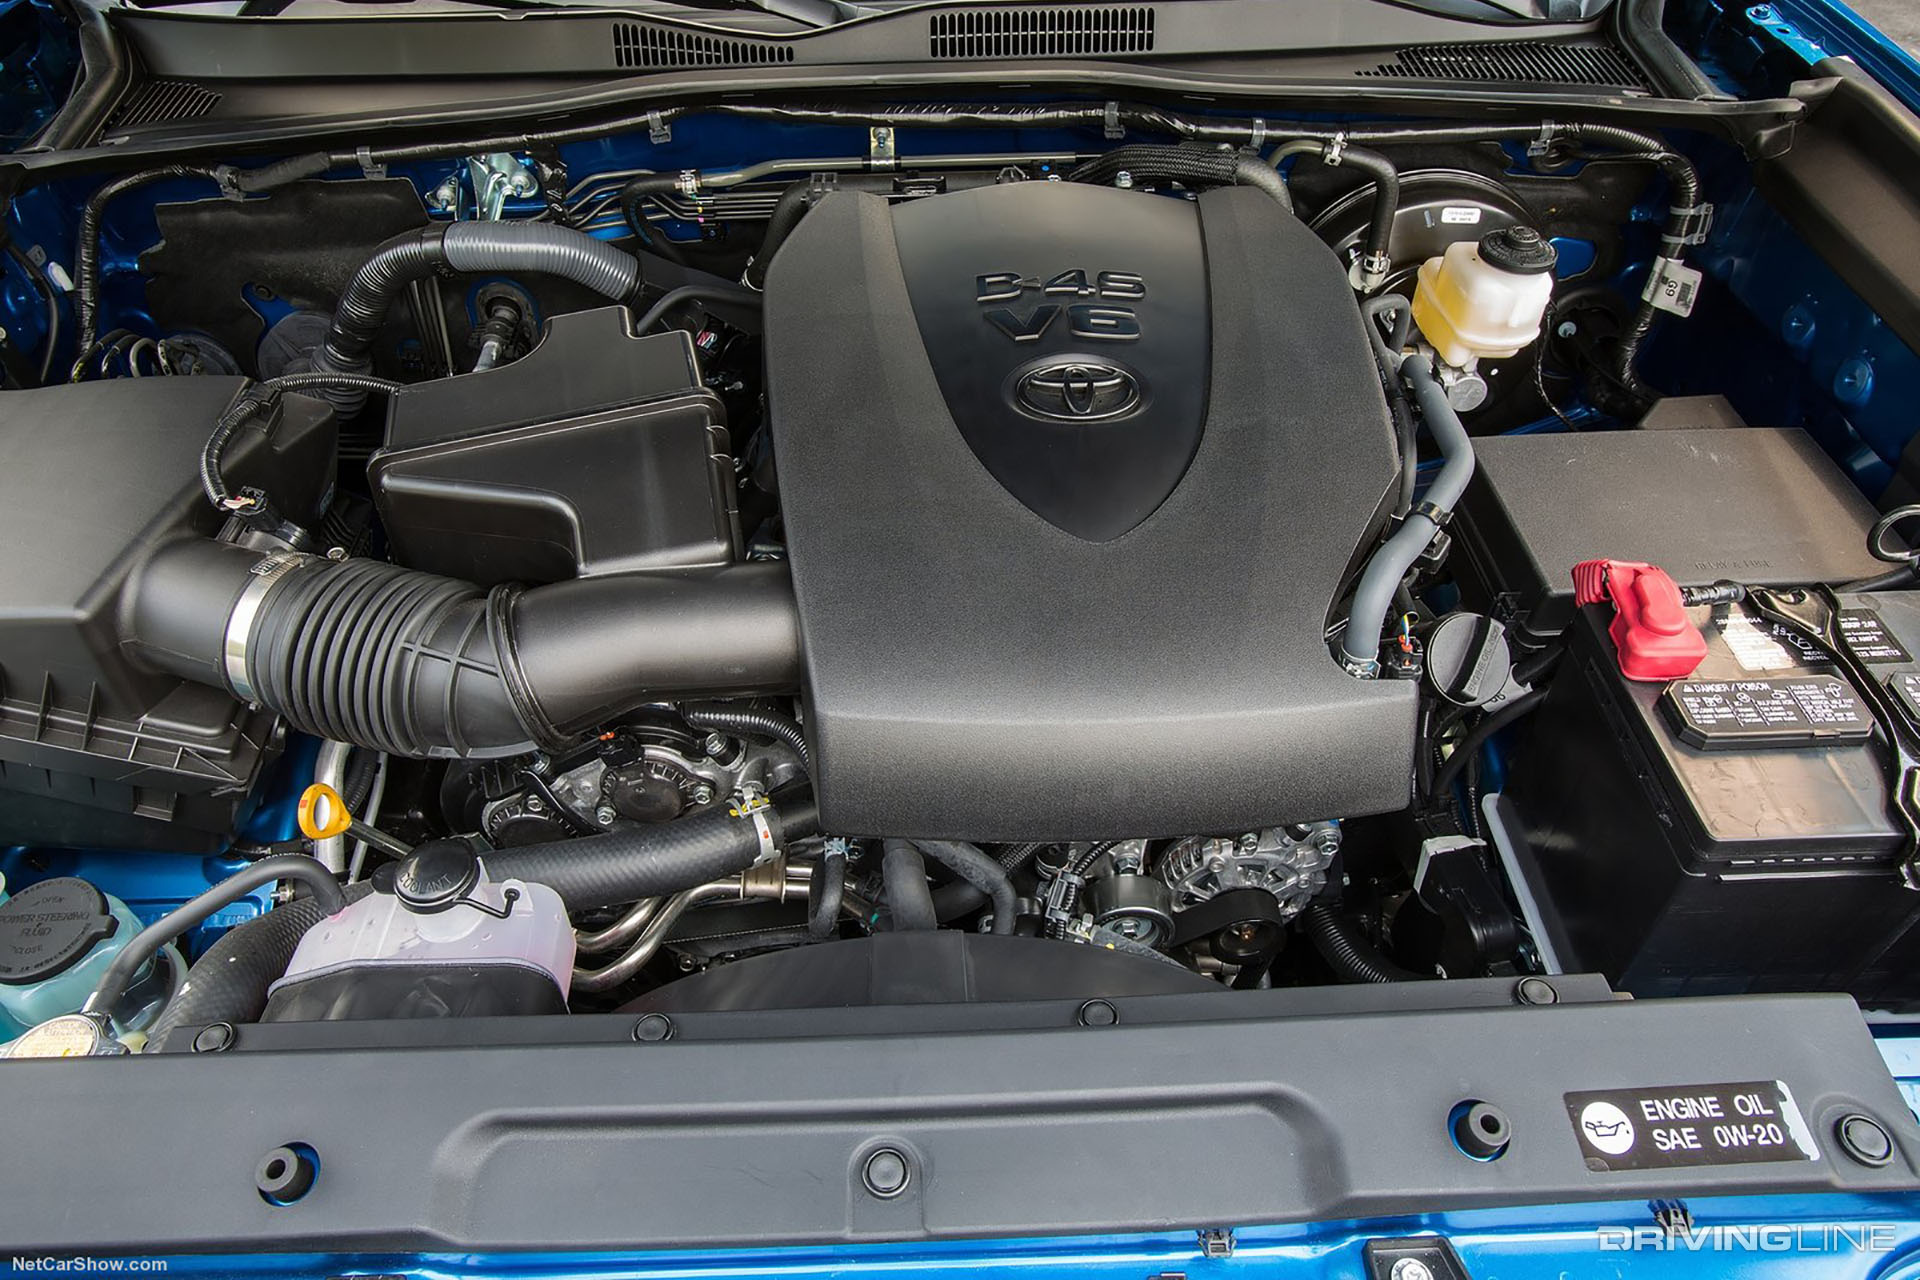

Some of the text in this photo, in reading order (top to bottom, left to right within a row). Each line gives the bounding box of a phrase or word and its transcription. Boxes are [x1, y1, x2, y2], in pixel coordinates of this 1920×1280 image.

[976, 268, 1146, 302] D-4S
[1664, 279, 1678, 297] G9
[982, 303, 1142, 342] V6
[400, 872, 452, 895] COOLANT
[38, 911, 90, 922] STEERING
[1640, 1094, 1774, 1122] ENGINE OIL
[1653, 1123, 1784, 1151] SAE 0W-20
